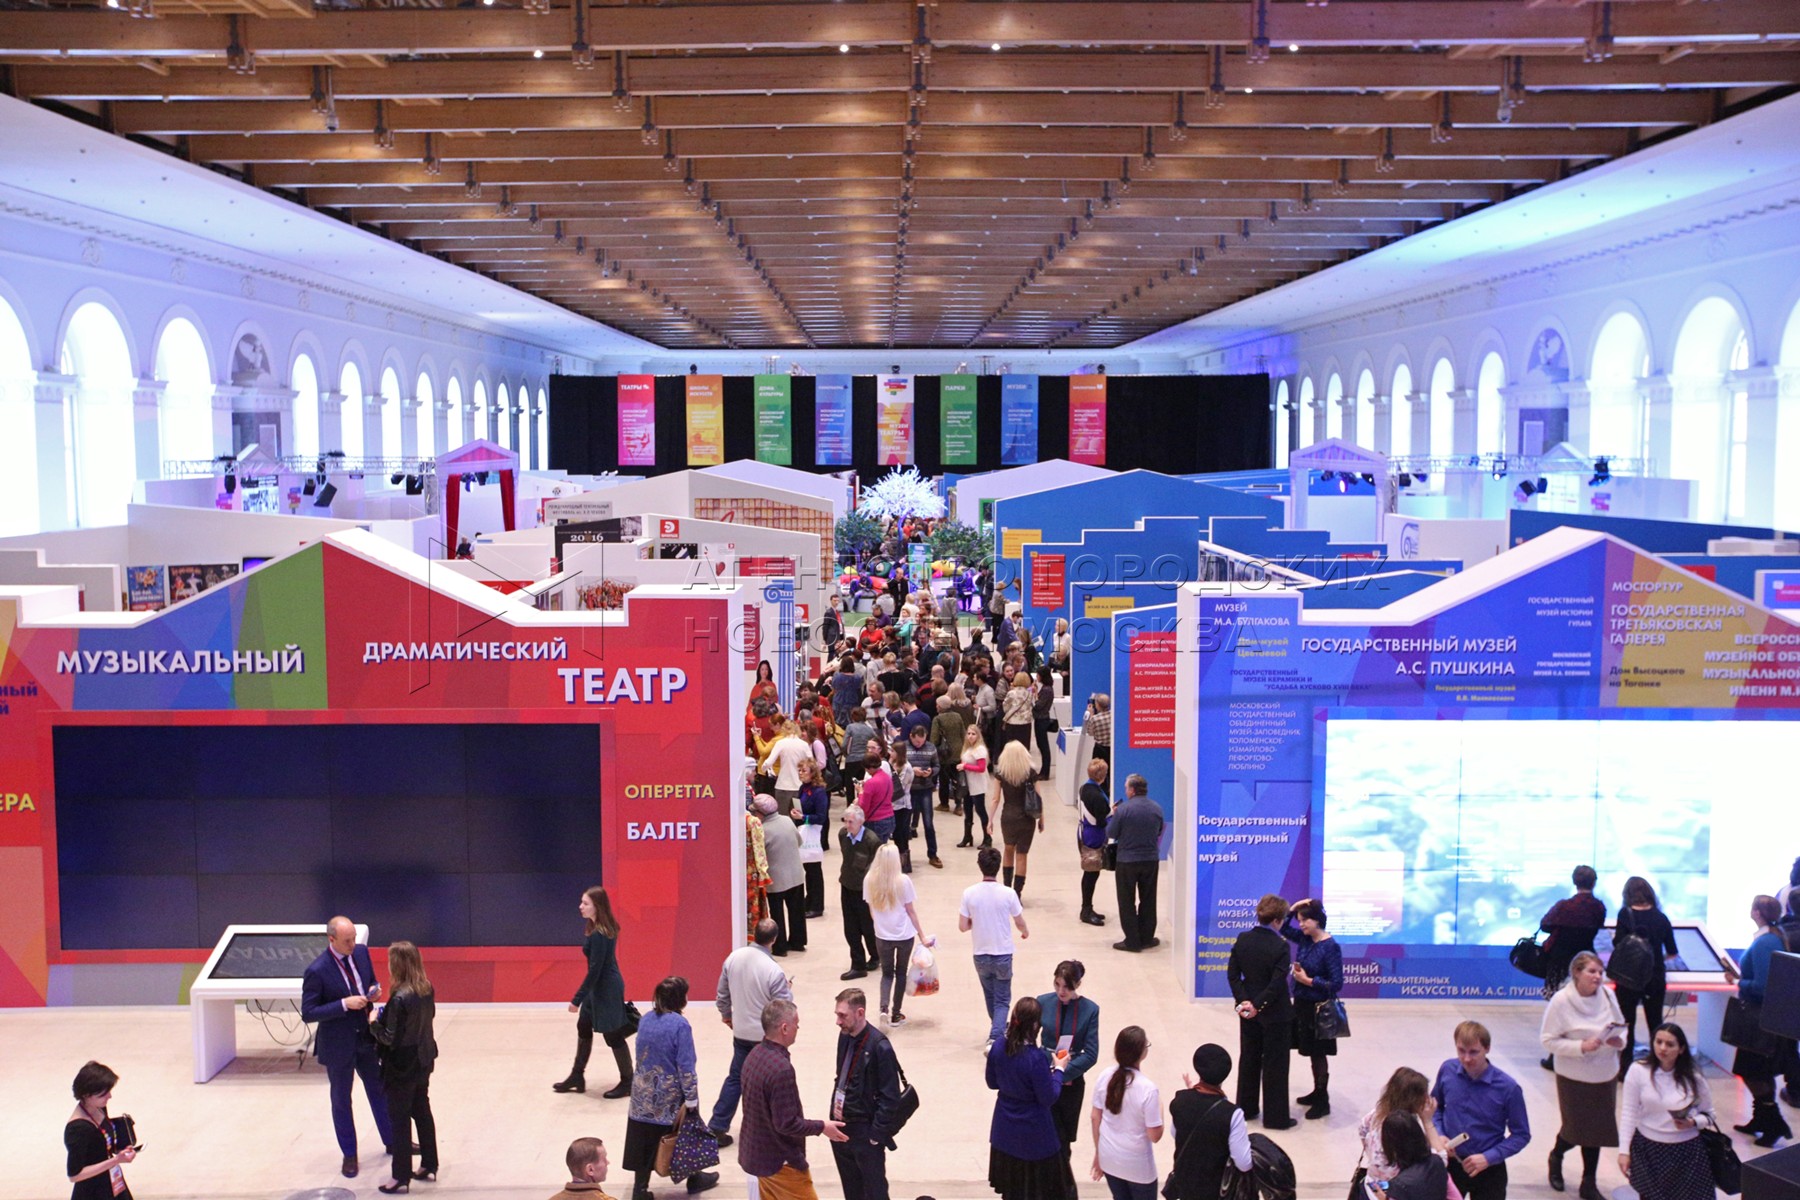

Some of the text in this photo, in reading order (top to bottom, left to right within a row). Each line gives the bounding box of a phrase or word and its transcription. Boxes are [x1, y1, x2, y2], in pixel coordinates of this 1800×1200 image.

[1612, 582, 1684, 593] МОСГОРТУР
[1214, 602, 1248, 612] МУЗЕЙ
[1536, 608, 1560, 616] МУЗЕЙ
[1611, 604, 1745, 618] ГОСУДАРСТВЕННАЯ
[1214, 618, 1290, 626] М.А. БУЛГАКОВА
[1610, 618, 1723, 632] ТРЕТЬЯКОВСКАЯ
[1302, 636, 1517, 654] ГОСУДАРСТВЕННЫЙ МУЗЕЙ
[1610, 632, 1666, 646] ГАЛЕРЕЯ
[363, 637, 568, 663] ДРАМАТИЧЕСКИЙ
[1704, 649, 1775, 662] МУЗЕЙНОЕ
[56, 643, 305, 674] МУЗЫКАЛЬНЫЙ
[1396, 661, 1515, 676] А.С. ПУШКИНА
[557, 667, 688, 704] ТЕАТР
[1729, 685, 1777, 697] ИМЕНИ
[1228, 710, 1296, 718] ГОСУДАРСТВЕННЫЙ
[1228, 728, 1301, 736] МУЗЕЙ-ЗАПОВЕДНИК
[624, 784, 714, 799] ОПЕРЕТТА
[1198, 814, 1308, 827] Государственный
[626, 821, 700, 841] БАЛЕТ
[1198, 832, 1289, 845] литературный
[1198, 851, 1239, 865] музей
[1218, 898, 1260, 907] МОСКОВ
[1362, 976, 1450, 985] ИЗОБРАЗИТЕЛЬНЫХ
[1402, 986, 1459, 997] ИСКУССТВ
[1461, 986, 1483, 996] ИМ.
[1485, 986, 1507, 996] А.С.
